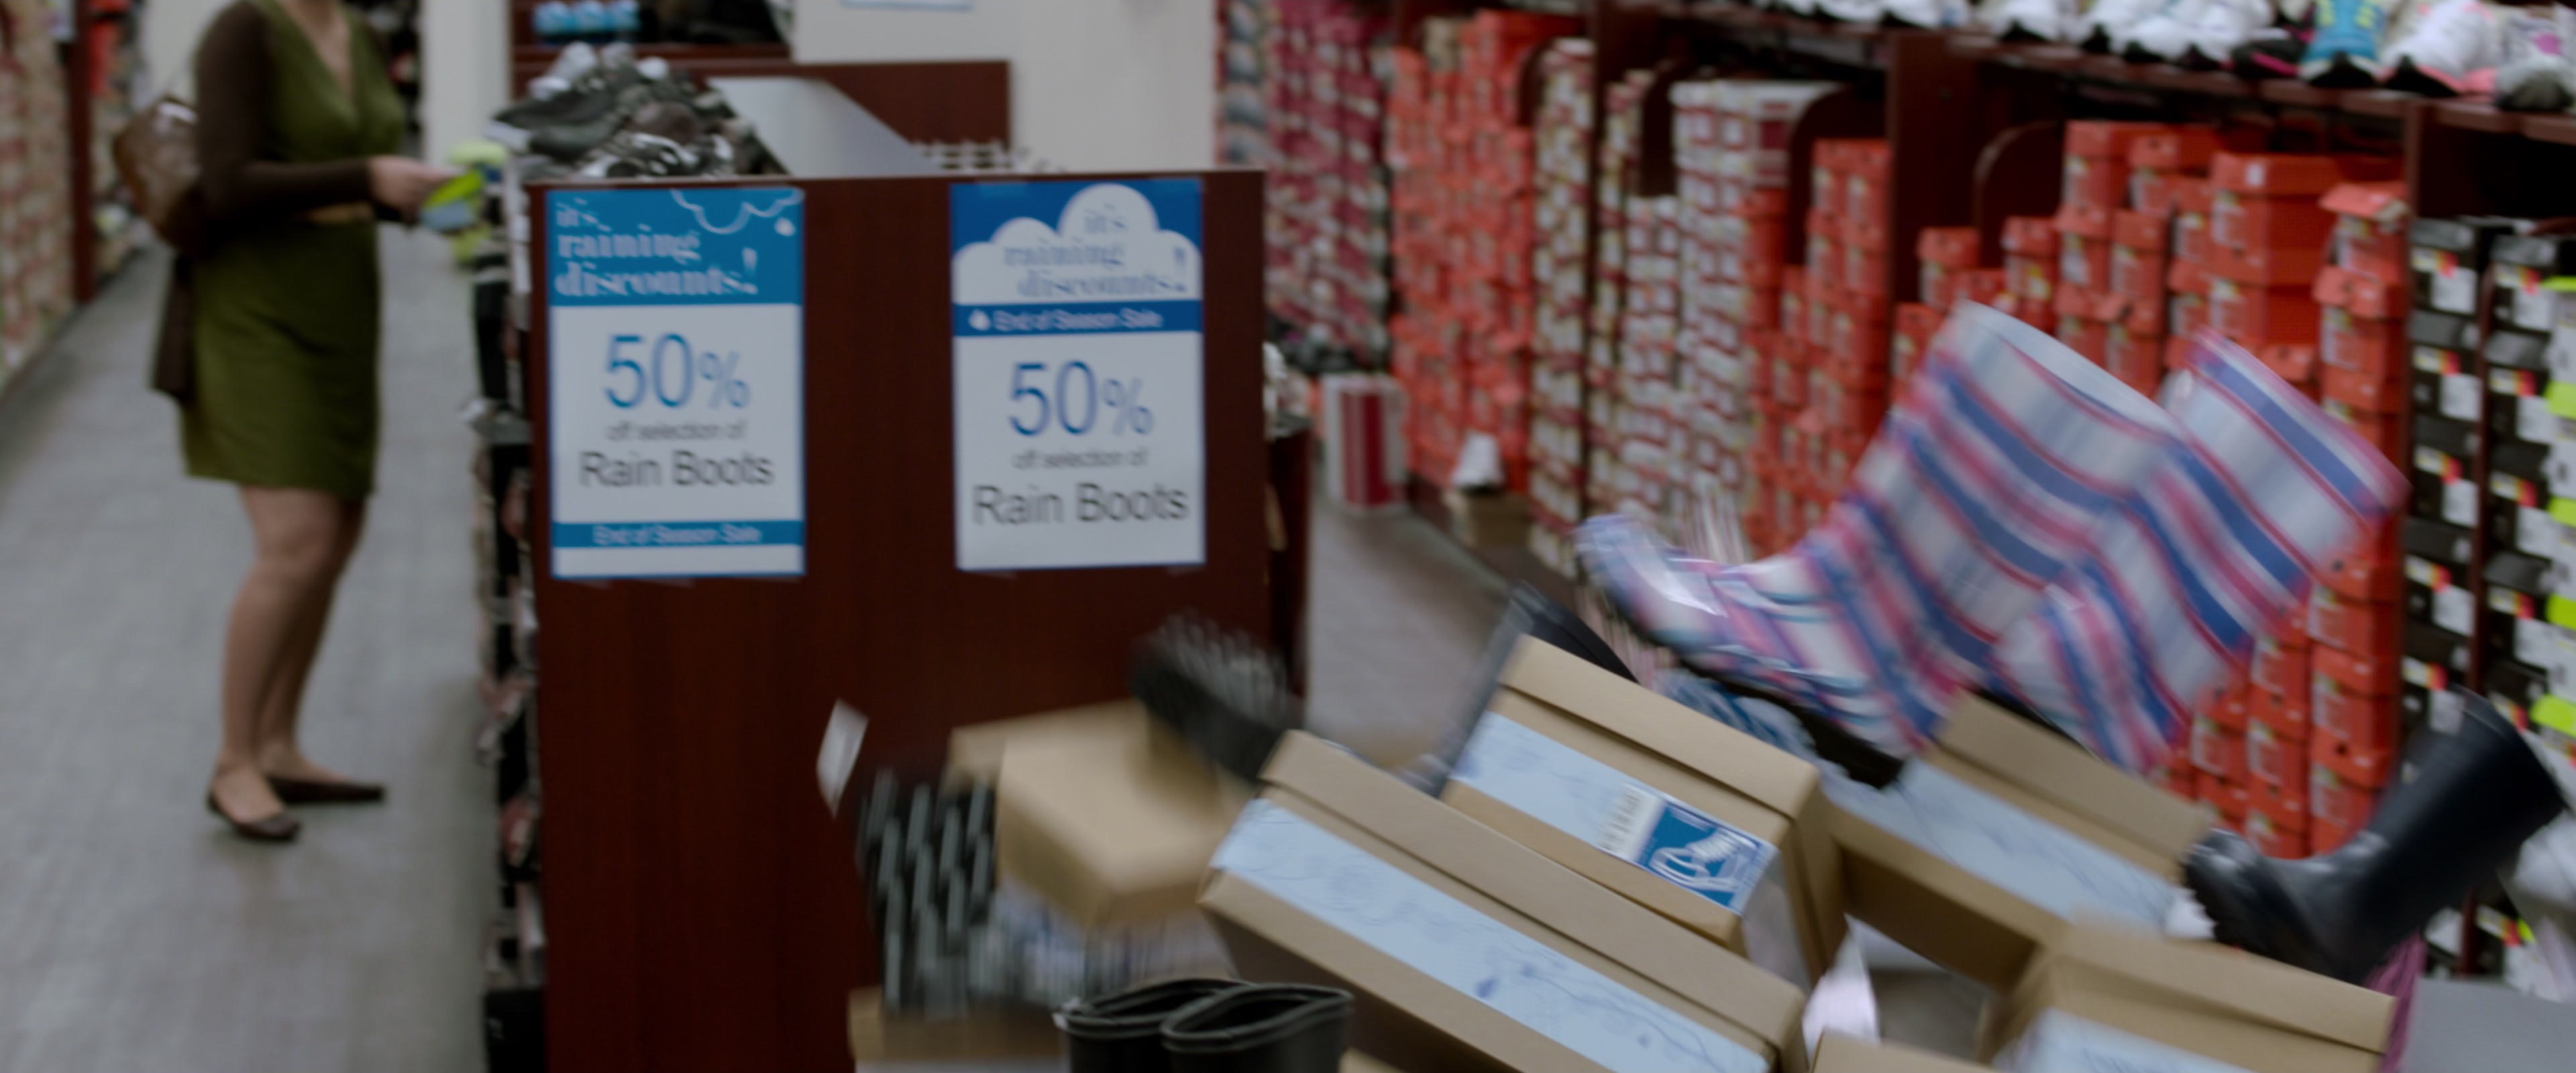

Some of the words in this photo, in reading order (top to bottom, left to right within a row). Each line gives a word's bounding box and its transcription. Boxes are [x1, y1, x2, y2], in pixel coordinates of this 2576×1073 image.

[557, 223, 701, 266] raining
[1004, 236, 1125, 271] raining
[604, 333, 751, 408] 50%
[1008, 359, 1155, 437] 50%
[637, 419, 720, 441] selection
[725, 418, 748, 439] of
[578, 450, 663, 488] Rain
[672, 449, 775, 486] Boots
[1041, 447, 1123, 468] selection
[1126, 445, 1150, 467] of
[972, 483, 1065, 526] Rain
[1075, 482, 1190, 522] Boots
